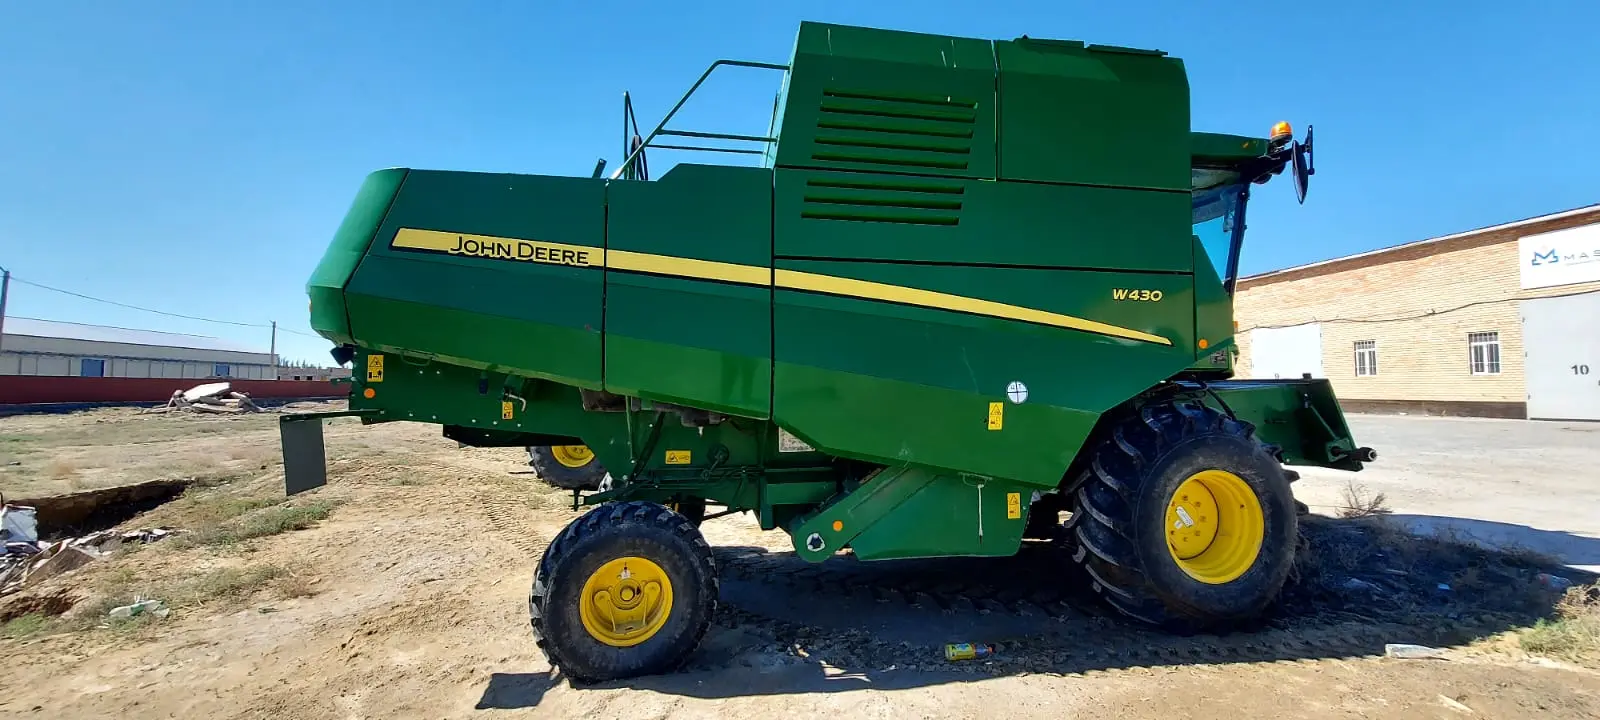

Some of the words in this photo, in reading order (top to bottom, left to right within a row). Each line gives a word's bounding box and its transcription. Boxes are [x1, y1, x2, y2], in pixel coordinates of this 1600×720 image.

[450, 235, 511, 257] JOHN
[517, 242, 589, 265] DEERE
[1112, 288, 1163, 302] W430
[1571, 364, 1590, 375] 10
